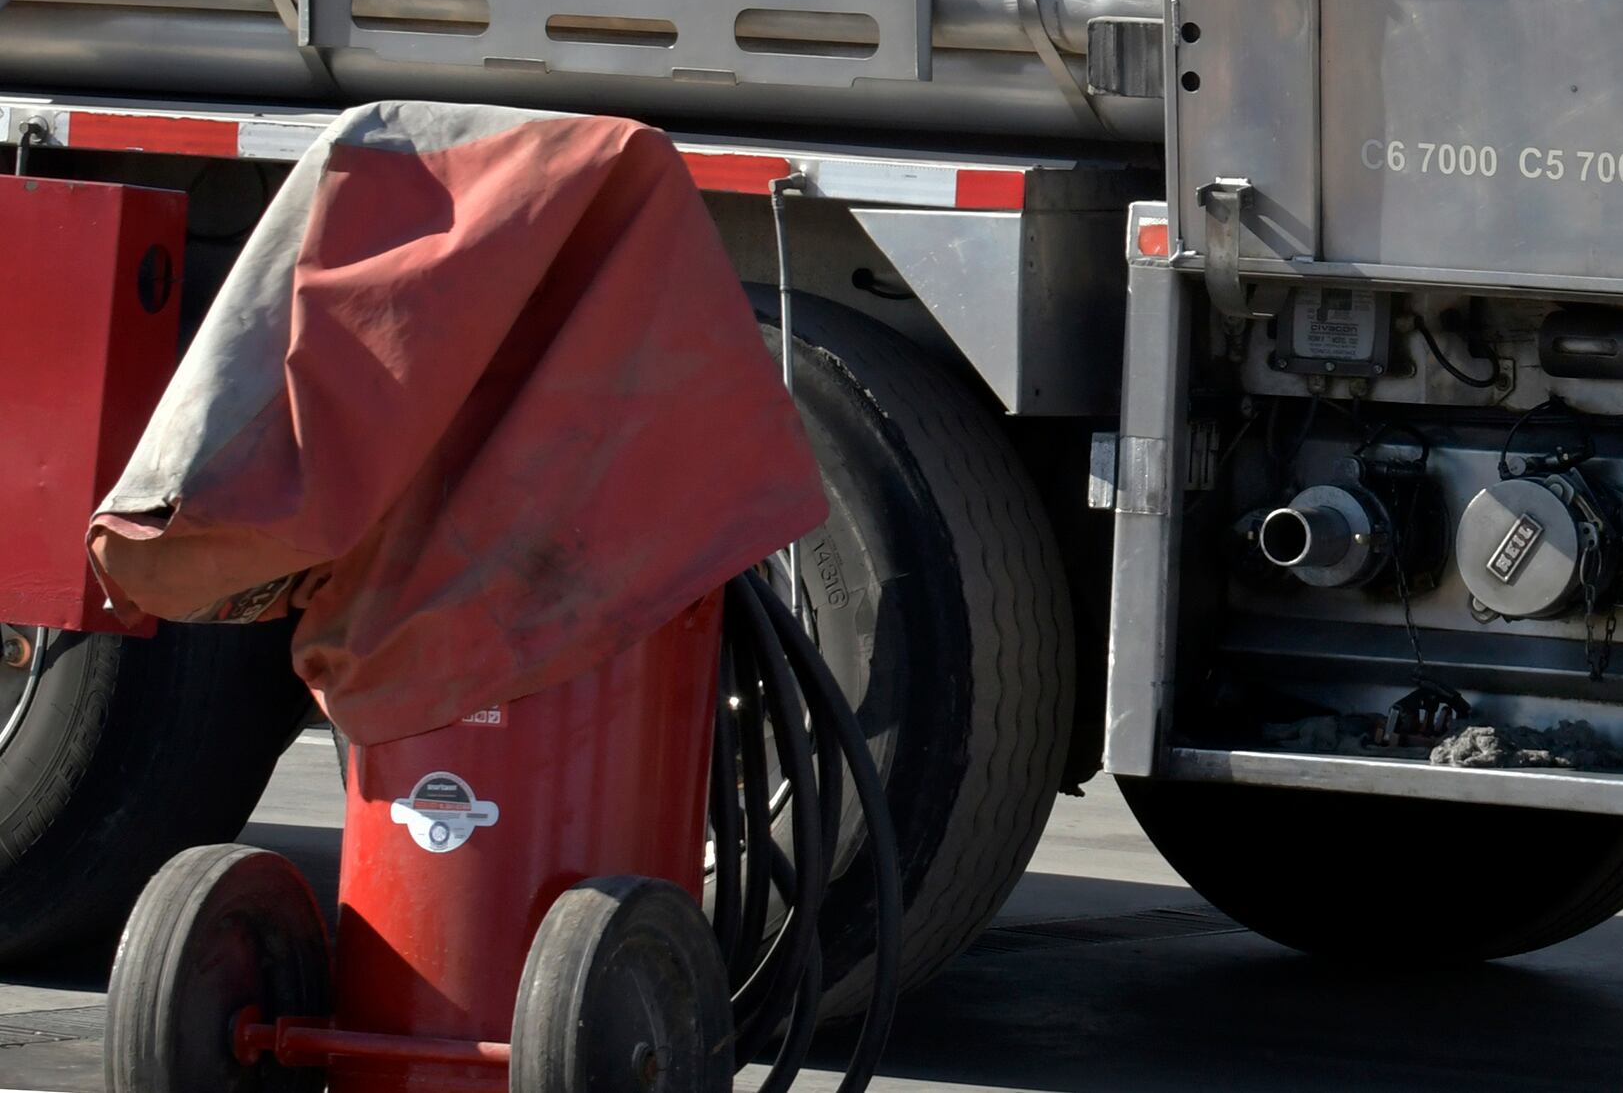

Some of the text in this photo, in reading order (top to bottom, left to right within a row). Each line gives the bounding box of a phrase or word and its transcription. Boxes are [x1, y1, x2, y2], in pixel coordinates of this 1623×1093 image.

[1361, 138, 1406, 172] C6
[1417, 142, 1498, 177] 7000
[1518, 147, 1565, 181] C5
[1495, 525, 1535, 573] HEIL
